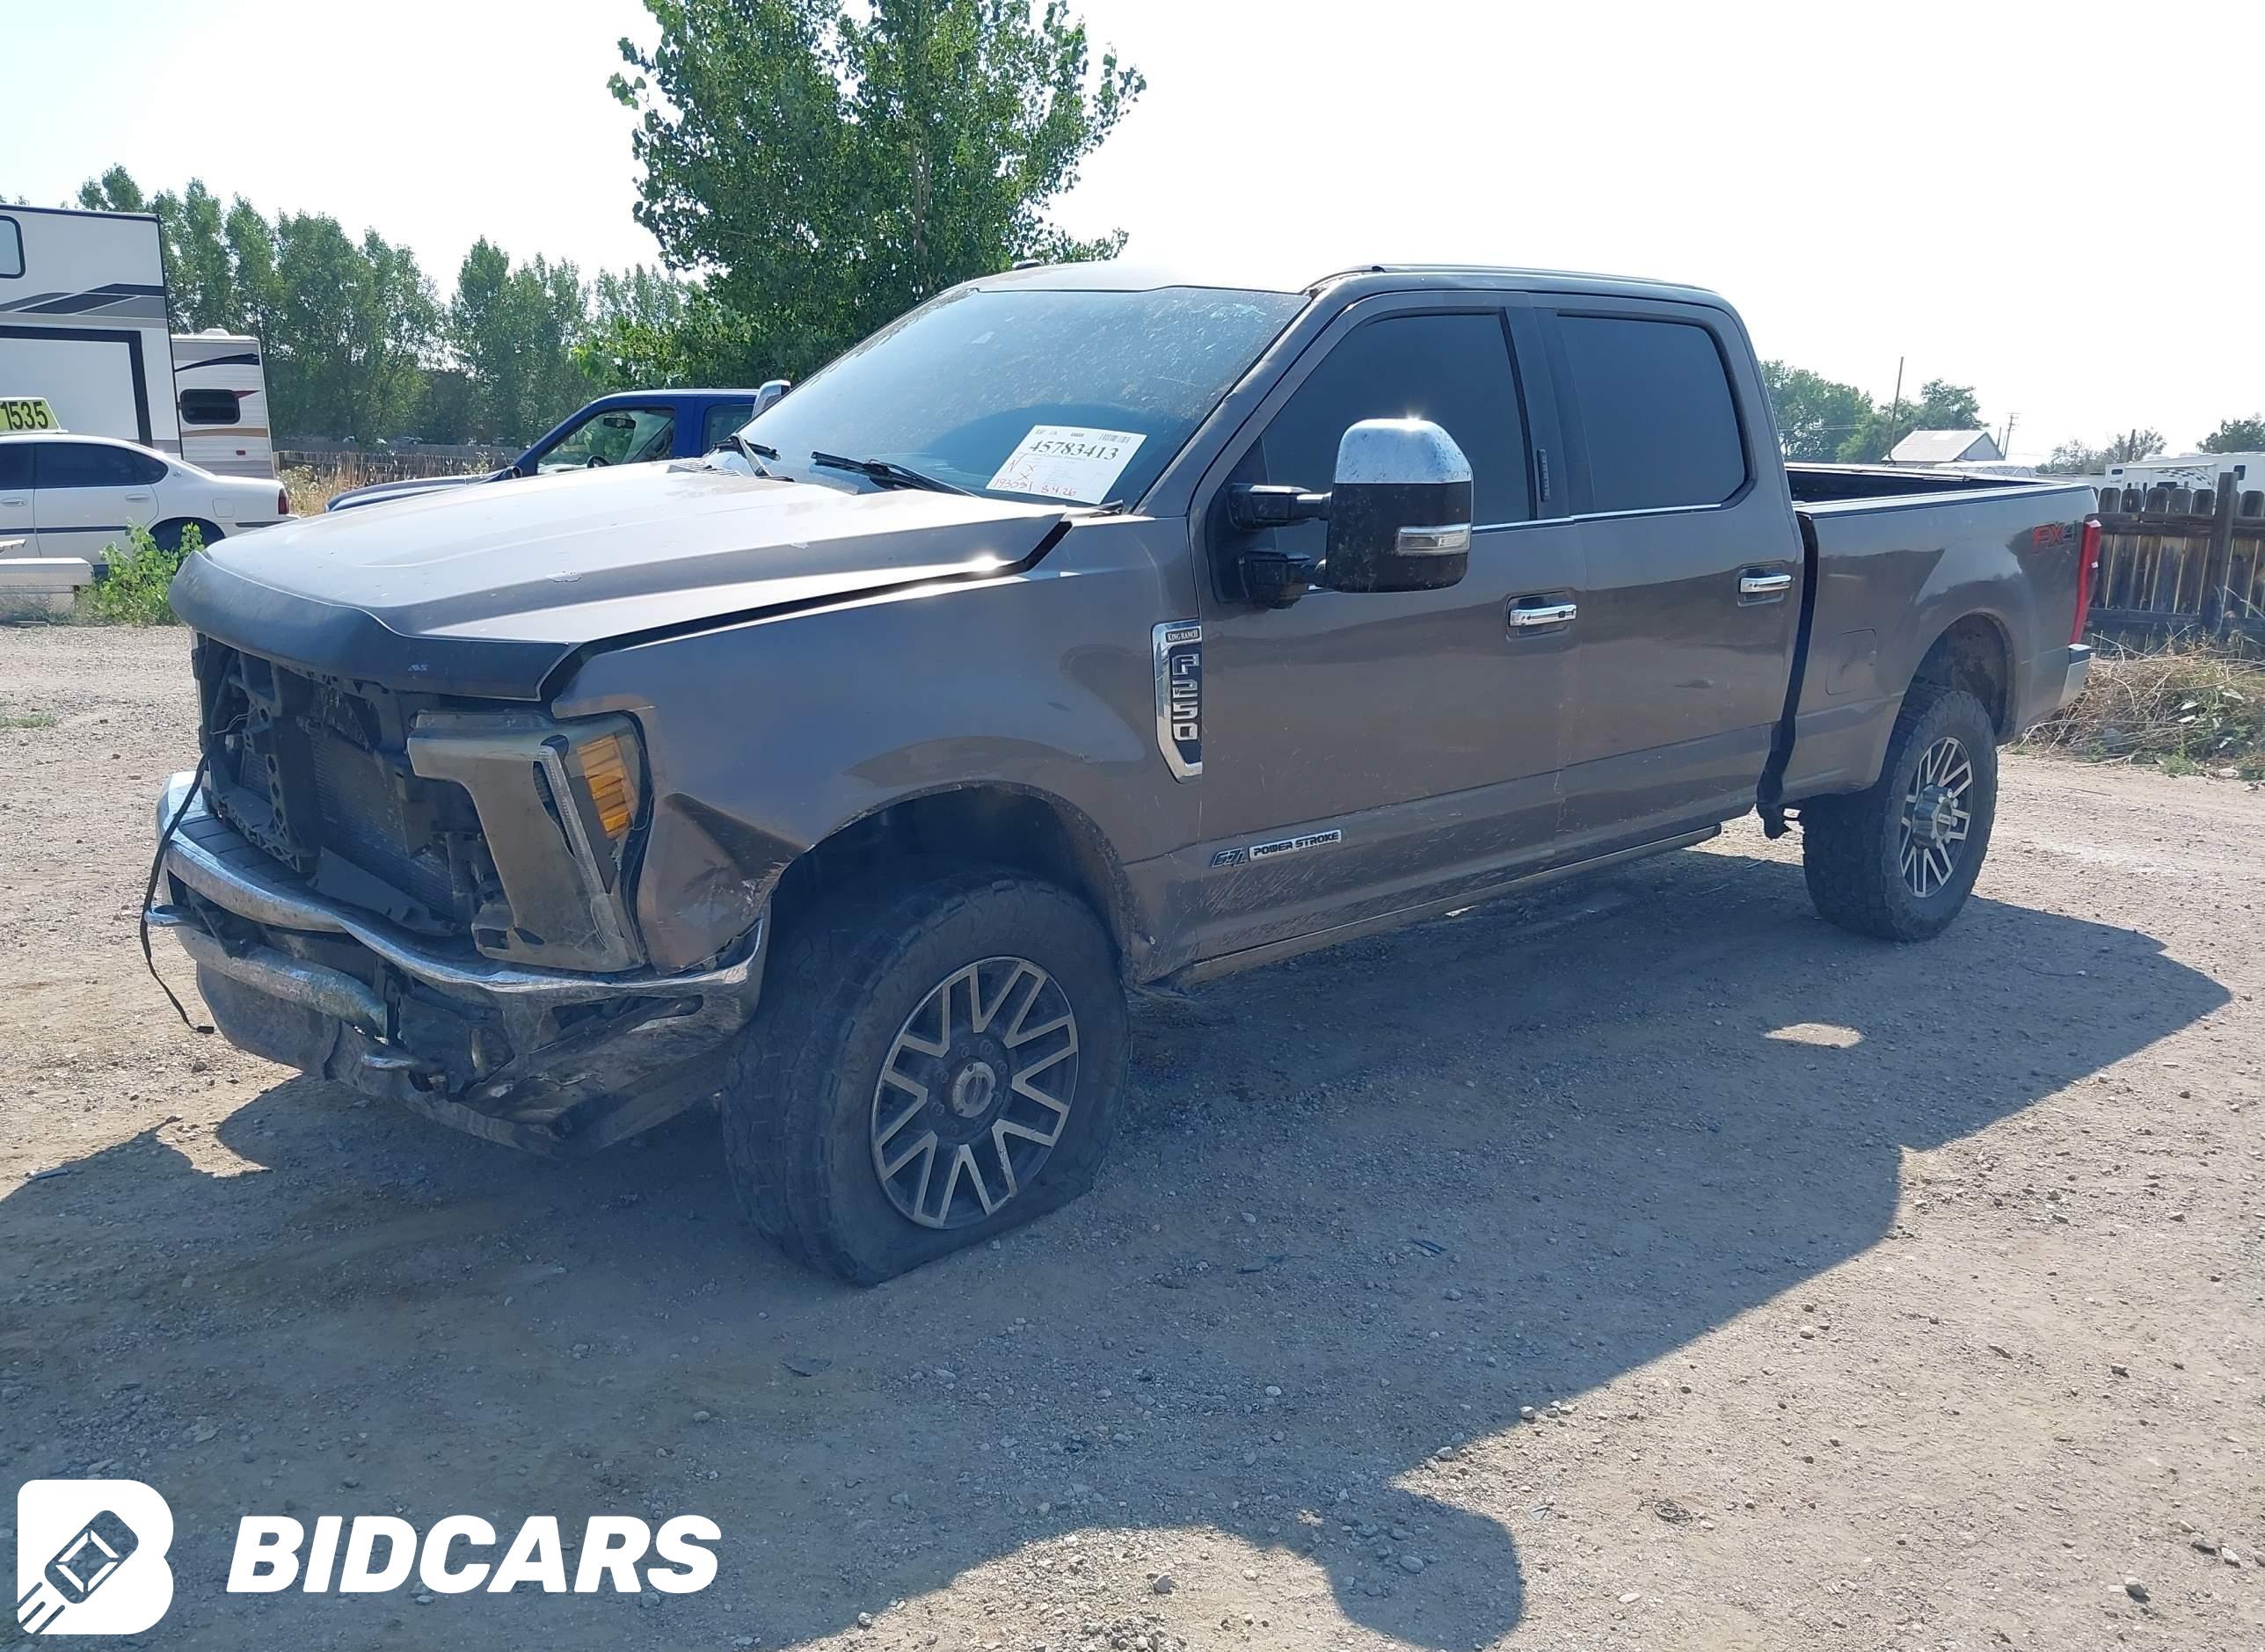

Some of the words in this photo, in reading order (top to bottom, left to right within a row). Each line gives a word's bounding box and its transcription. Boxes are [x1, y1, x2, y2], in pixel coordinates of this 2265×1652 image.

[1029, 440, 1119, 460] 45783413
[2032, 520, 2078, 554] FX4
[1253, 841, 1293, 856] POWER
[1295, 831, 1339, 848] STROKE
